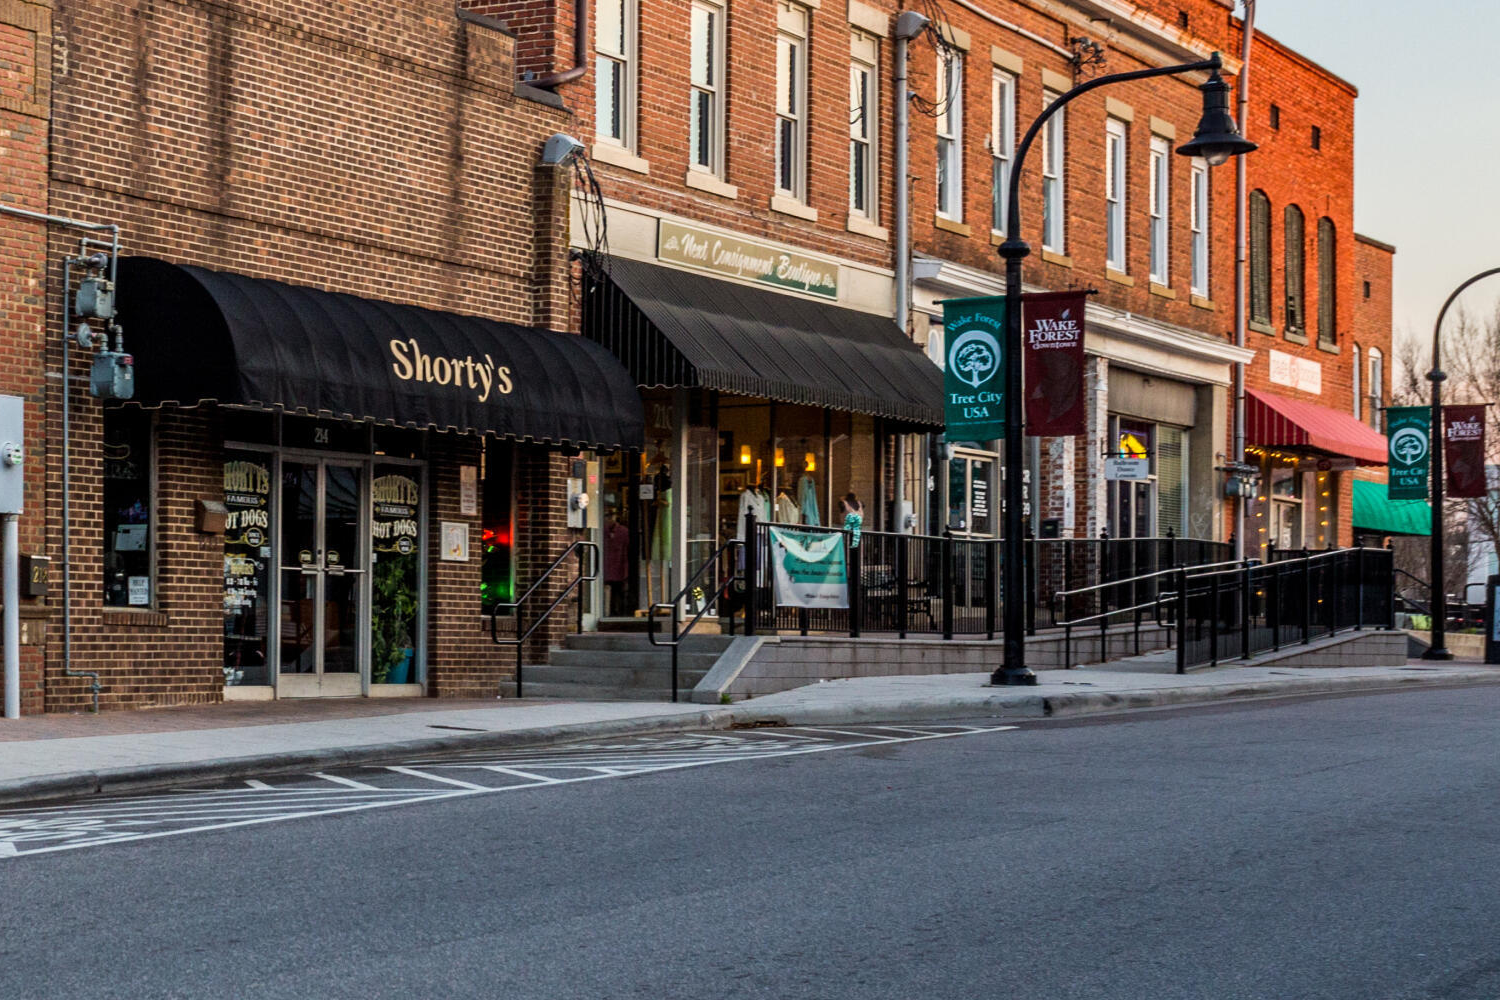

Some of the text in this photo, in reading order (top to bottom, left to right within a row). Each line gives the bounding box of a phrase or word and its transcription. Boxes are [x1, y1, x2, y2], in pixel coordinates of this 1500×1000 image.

[711, 239, 774, 276] Consignment
[776, 254, 821, 291] Boutique
[947, 312, 1002, 331] Wake Forest
[1028, 330, 1081, 344] FOREST
[1032, 341, 1078, 350] downtown
[390, 338, 513, 403] Shorty's
[950, 391, 1003, 405] Tree City
[963, 406, 990, 419] USA
[1447, 428, 1484, 438] FOREST
[1400, 477, 1420, 486] USA
[227, 494, 258, 504] FAMOUS
[241, 508, 268, 529] DOGS
[393, 519, 418, 538] DOGS
